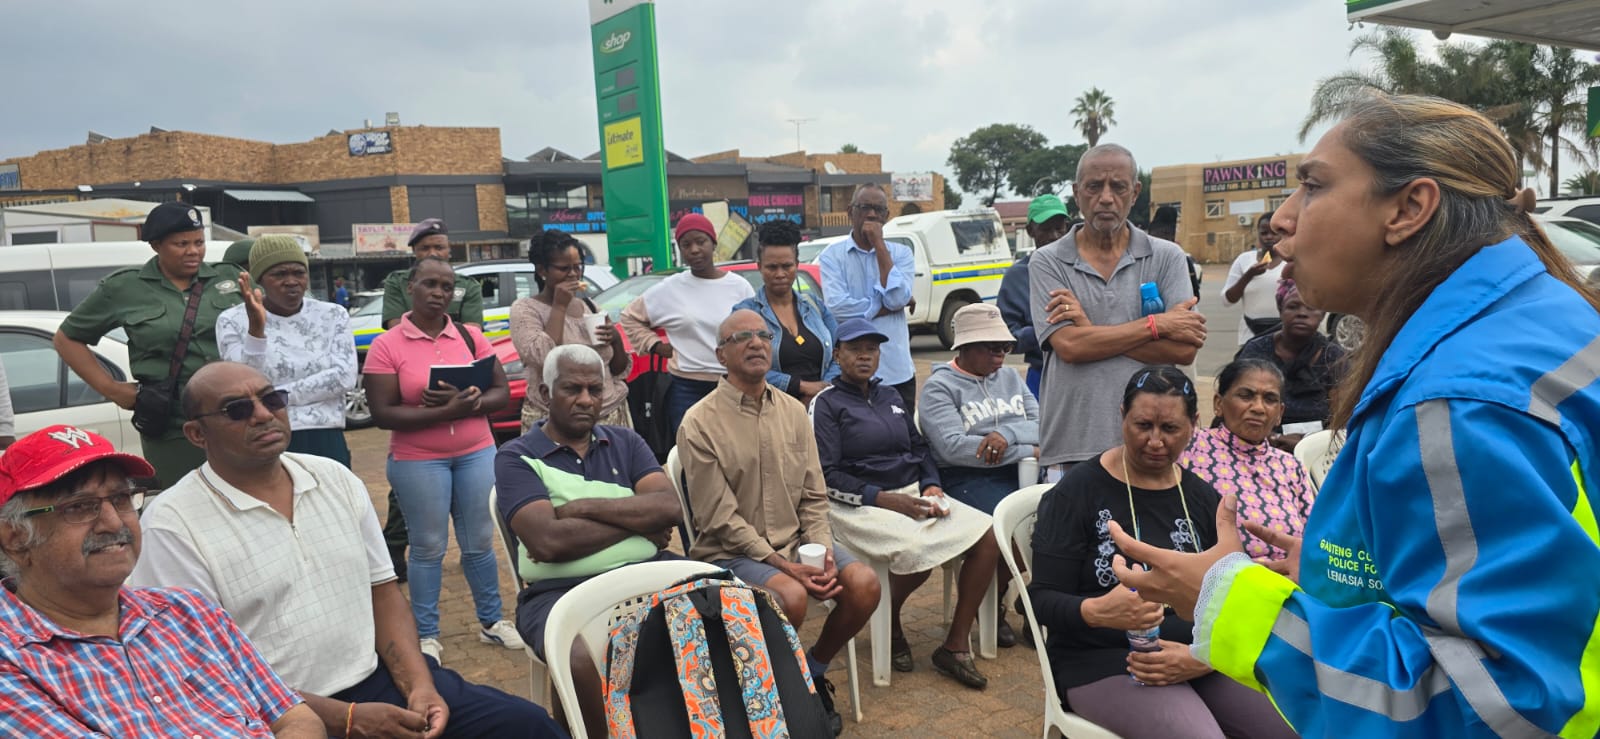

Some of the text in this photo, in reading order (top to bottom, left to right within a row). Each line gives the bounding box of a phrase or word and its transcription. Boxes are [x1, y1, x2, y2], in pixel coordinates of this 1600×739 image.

[604, 31, 631, 49] shop
[1205, 168, 1243, 183] PAWN
[1246, 162, 1285, 180] KING
[961, 394, 1027, 433] HICAG
[1320, 539, 1352, 558] GAUTENG
[1328, 555, 1359, 571] POLICE
[1327, 568, 1384, 590] LENASIA SO
